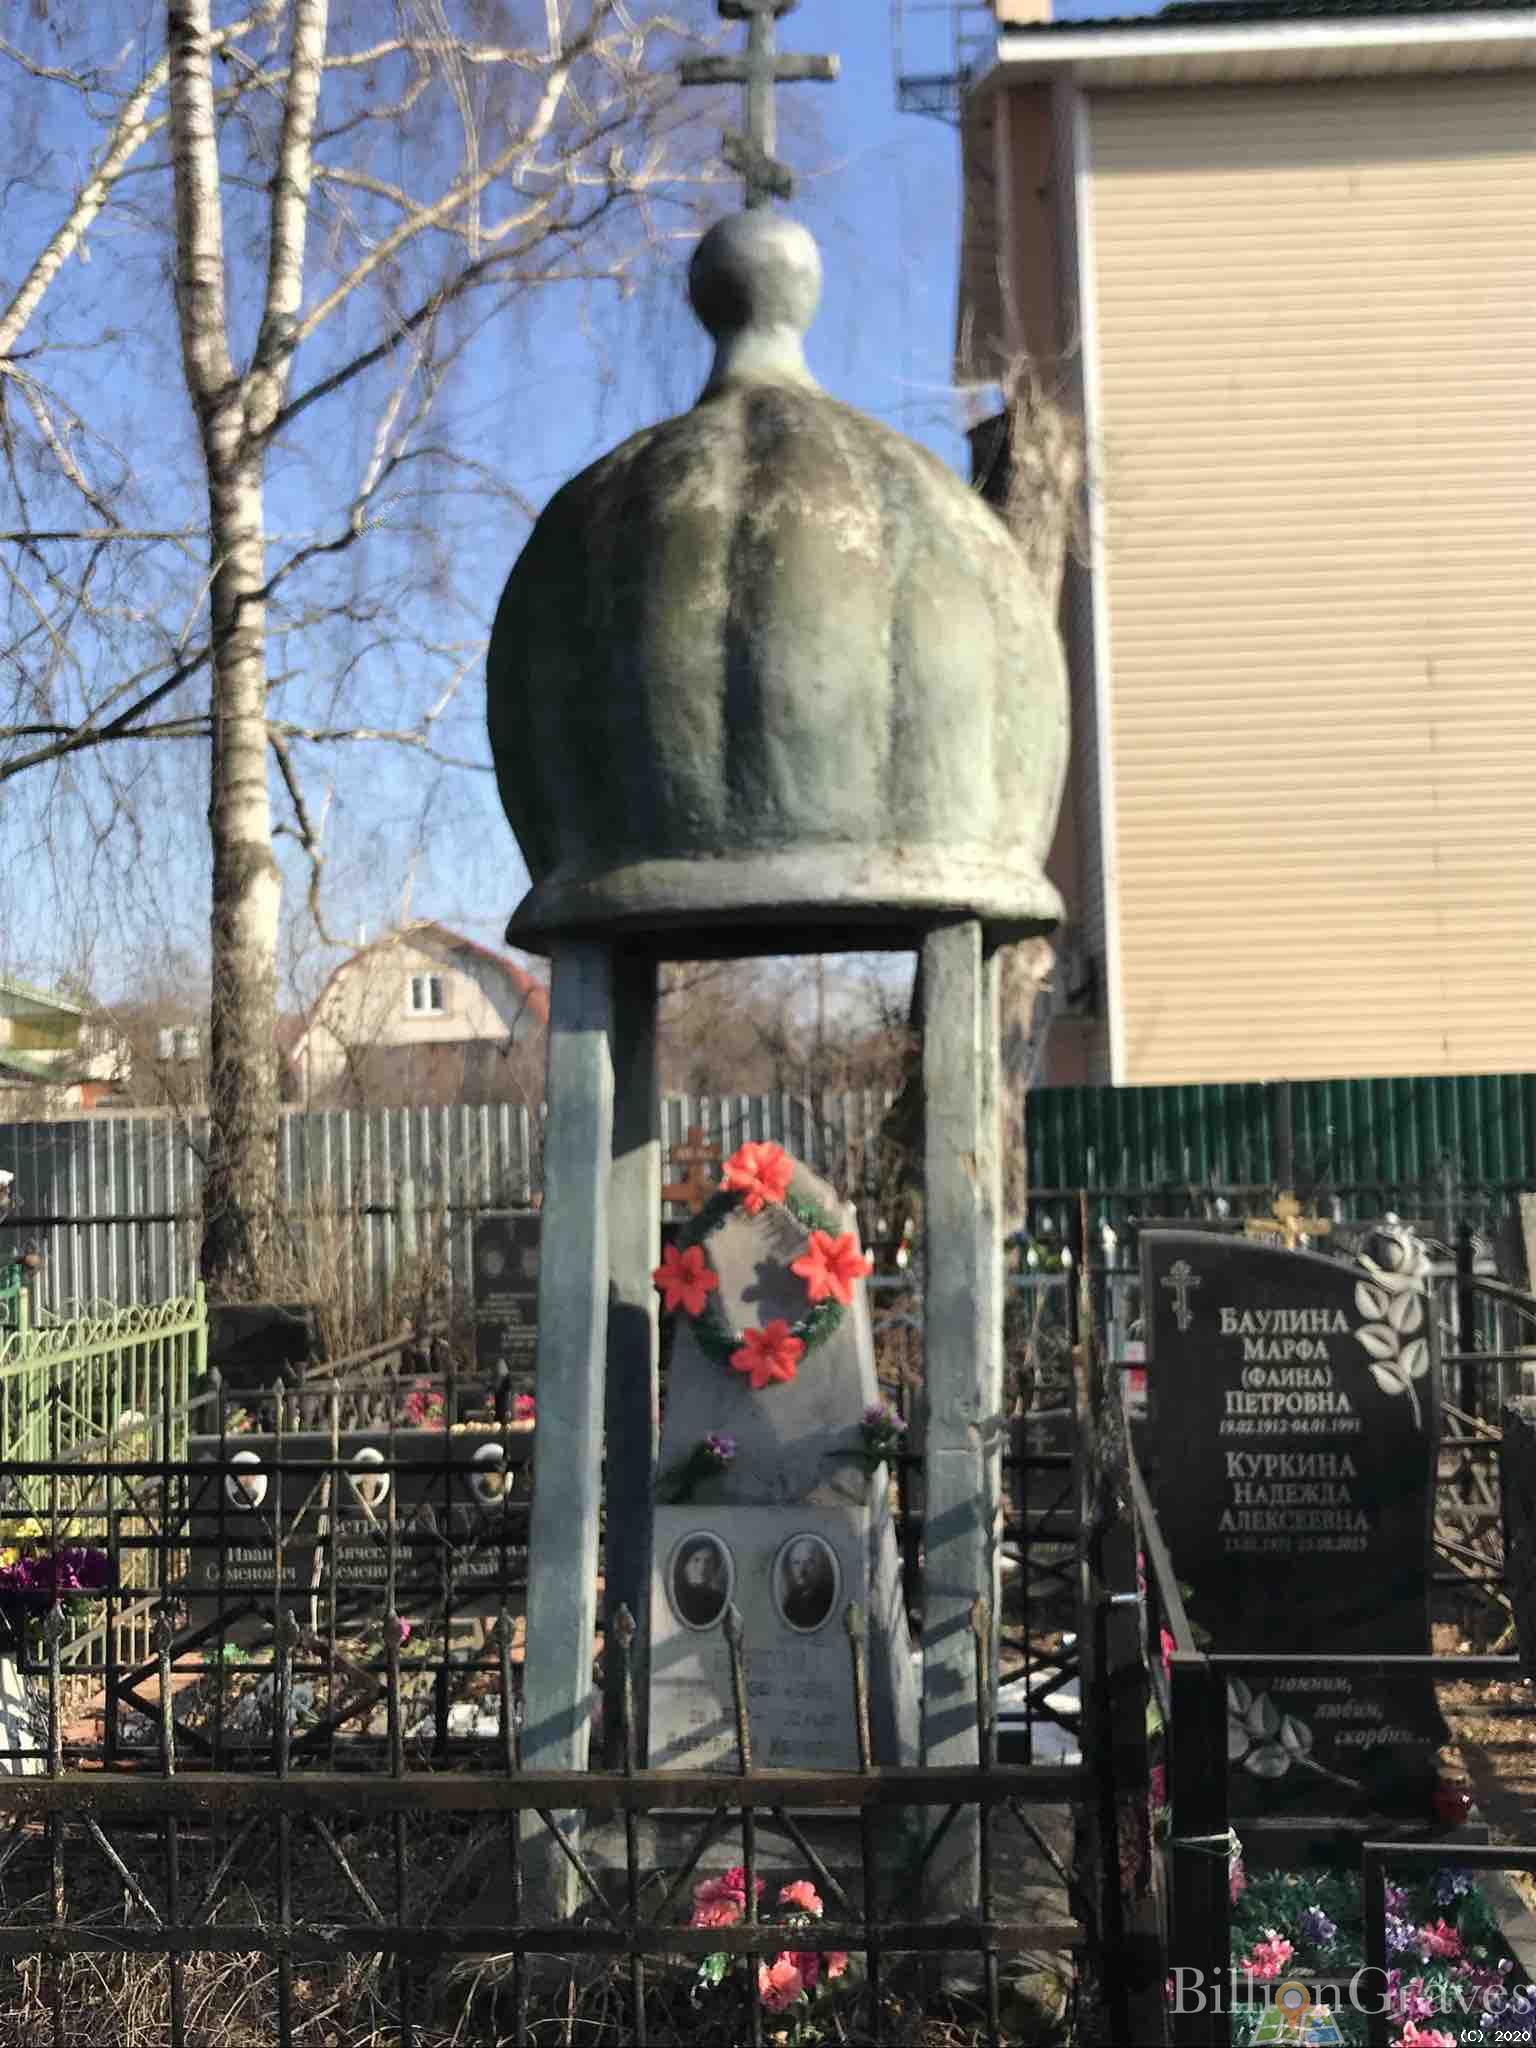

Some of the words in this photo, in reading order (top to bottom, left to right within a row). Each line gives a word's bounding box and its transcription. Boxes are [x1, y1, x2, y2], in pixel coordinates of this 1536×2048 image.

[1219, 1307, 1349, 1333] БАУЛИНА
[1243, 1338, 1328, 1361] МАРФА
[1241, 1366, 1333, 1388] (ФАИНА)
[1225, 1392, 1351, 1413] ПЕТРОВНА
[1225, 1452, 1357, 1478] КУРКИНА
[1234, 1483, 1351, 1504] НАДЕЖДА
[1218, 1509, 1370, 1532] АЛЕКСЕЕВНА
